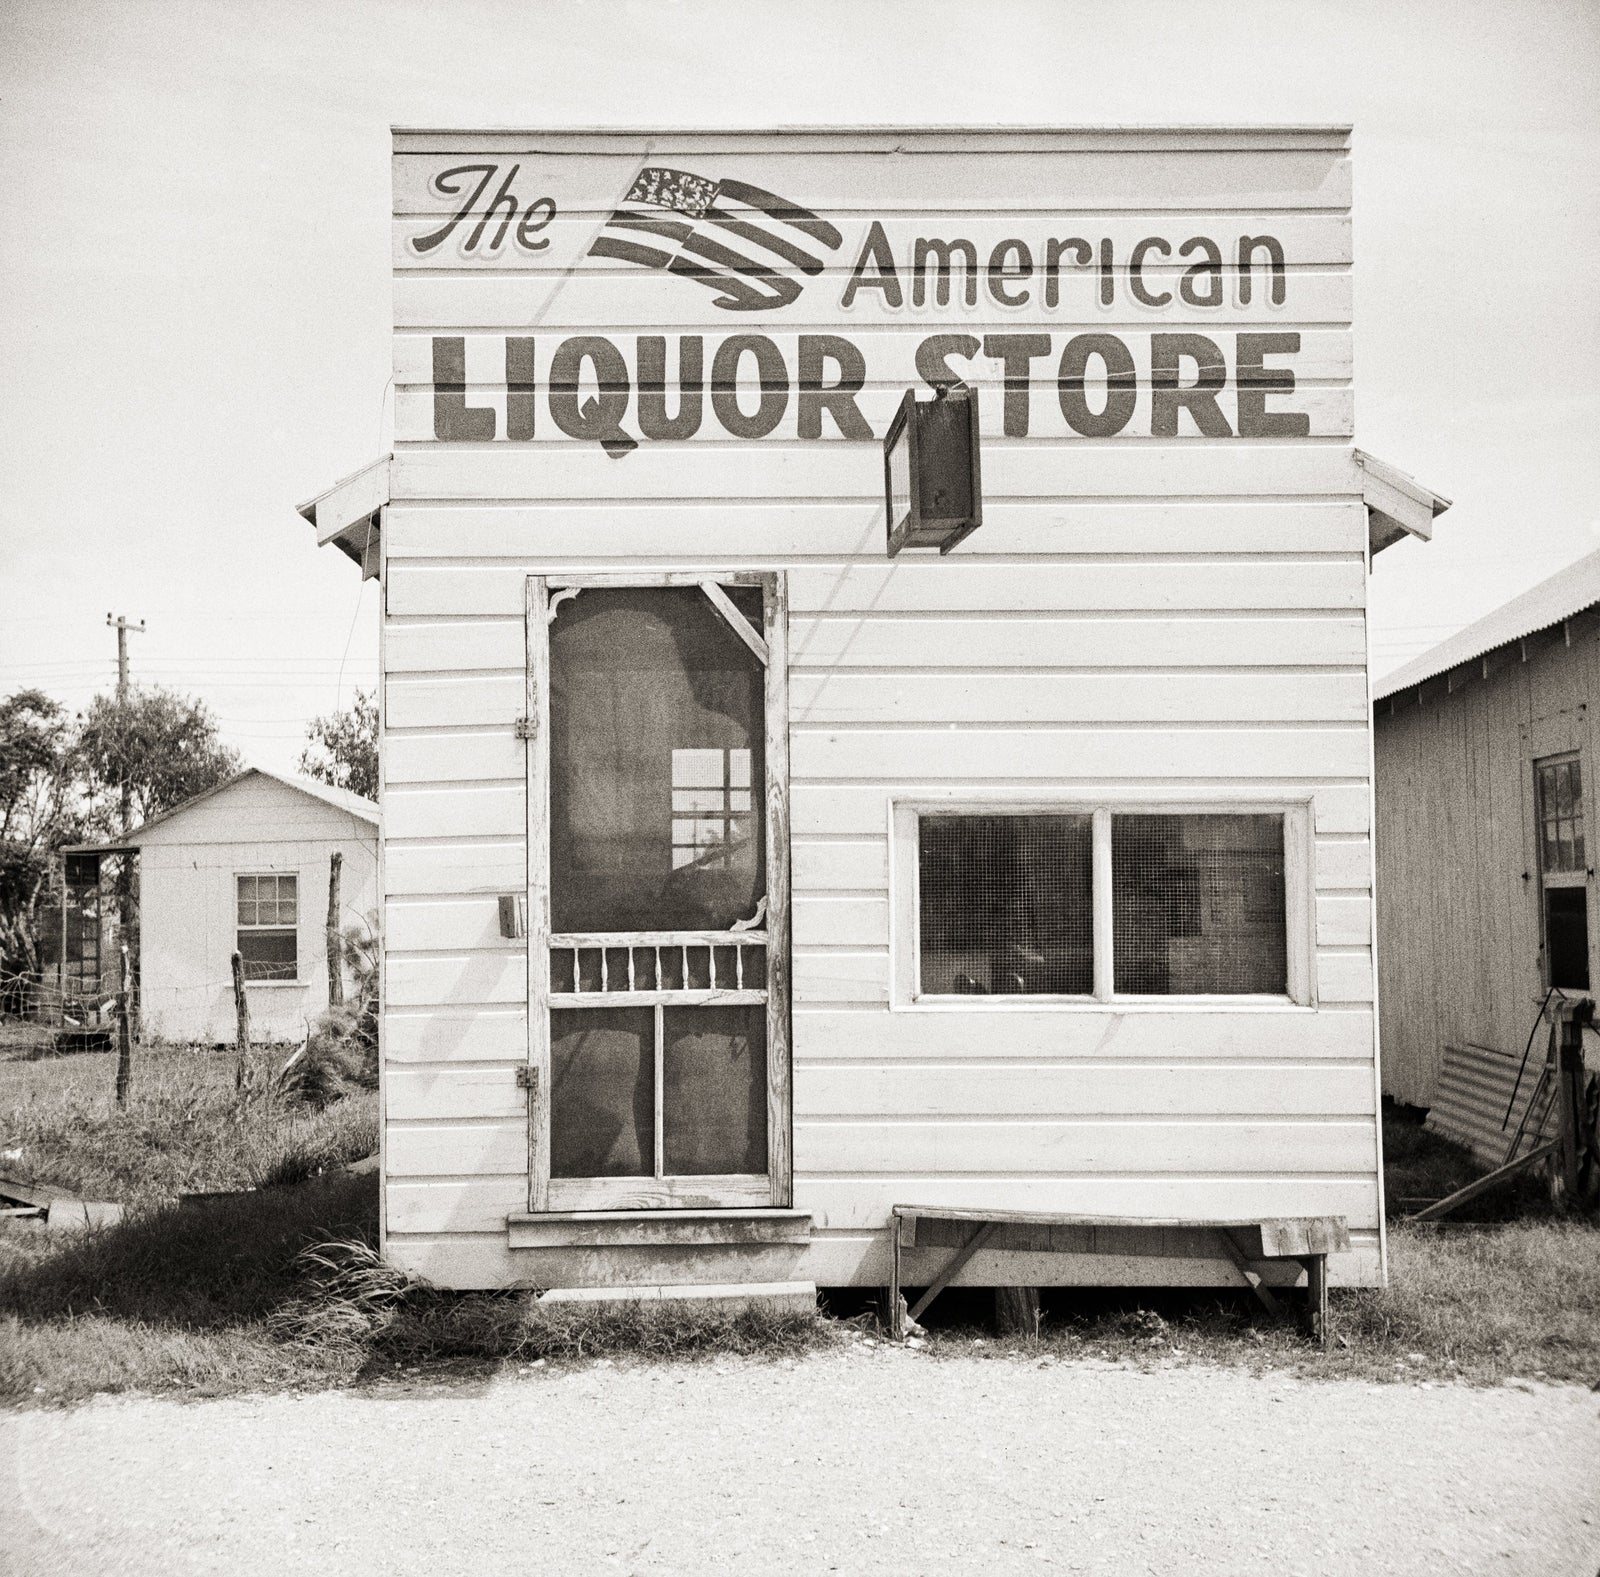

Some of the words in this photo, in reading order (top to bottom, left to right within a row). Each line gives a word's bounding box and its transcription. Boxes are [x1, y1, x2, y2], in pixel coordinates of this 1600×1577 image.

[412, 164, 556, 253] The
[841, 220, 1287, 308] American
[432, 334, 875, 459] LIQUOR
[914, 332, 1311, 438] STORE
